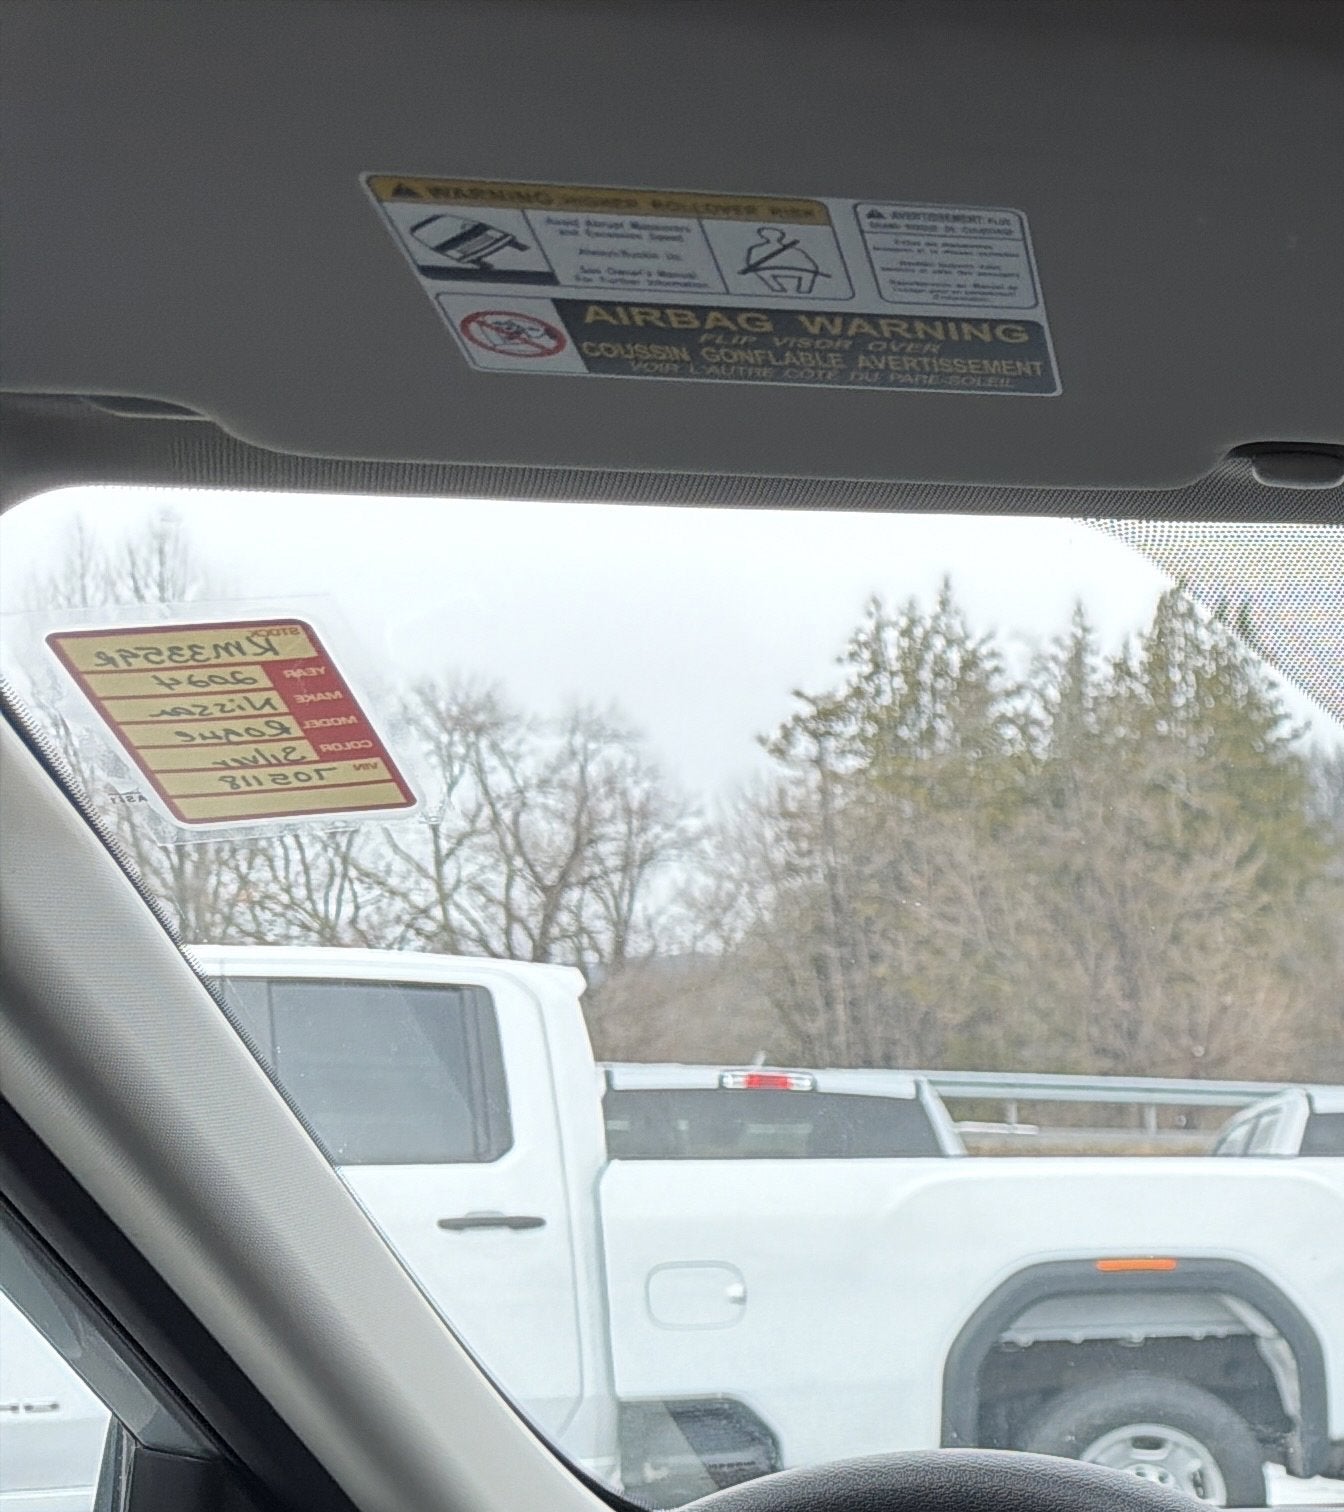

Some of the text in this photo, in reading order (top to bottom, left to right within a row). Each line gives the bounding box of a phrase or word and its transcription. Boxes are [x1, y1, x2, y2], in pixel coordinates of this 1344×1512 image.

[583, 305, 1030, 343] AIRBAG WARNING
[700, 332, 941, 354] FLIP VISOR OVER
[581, 341, 1043, 378] COUSSIN GONFLABLE AVERTISSEMENT
[630, 360, 679, 375] VOIR
